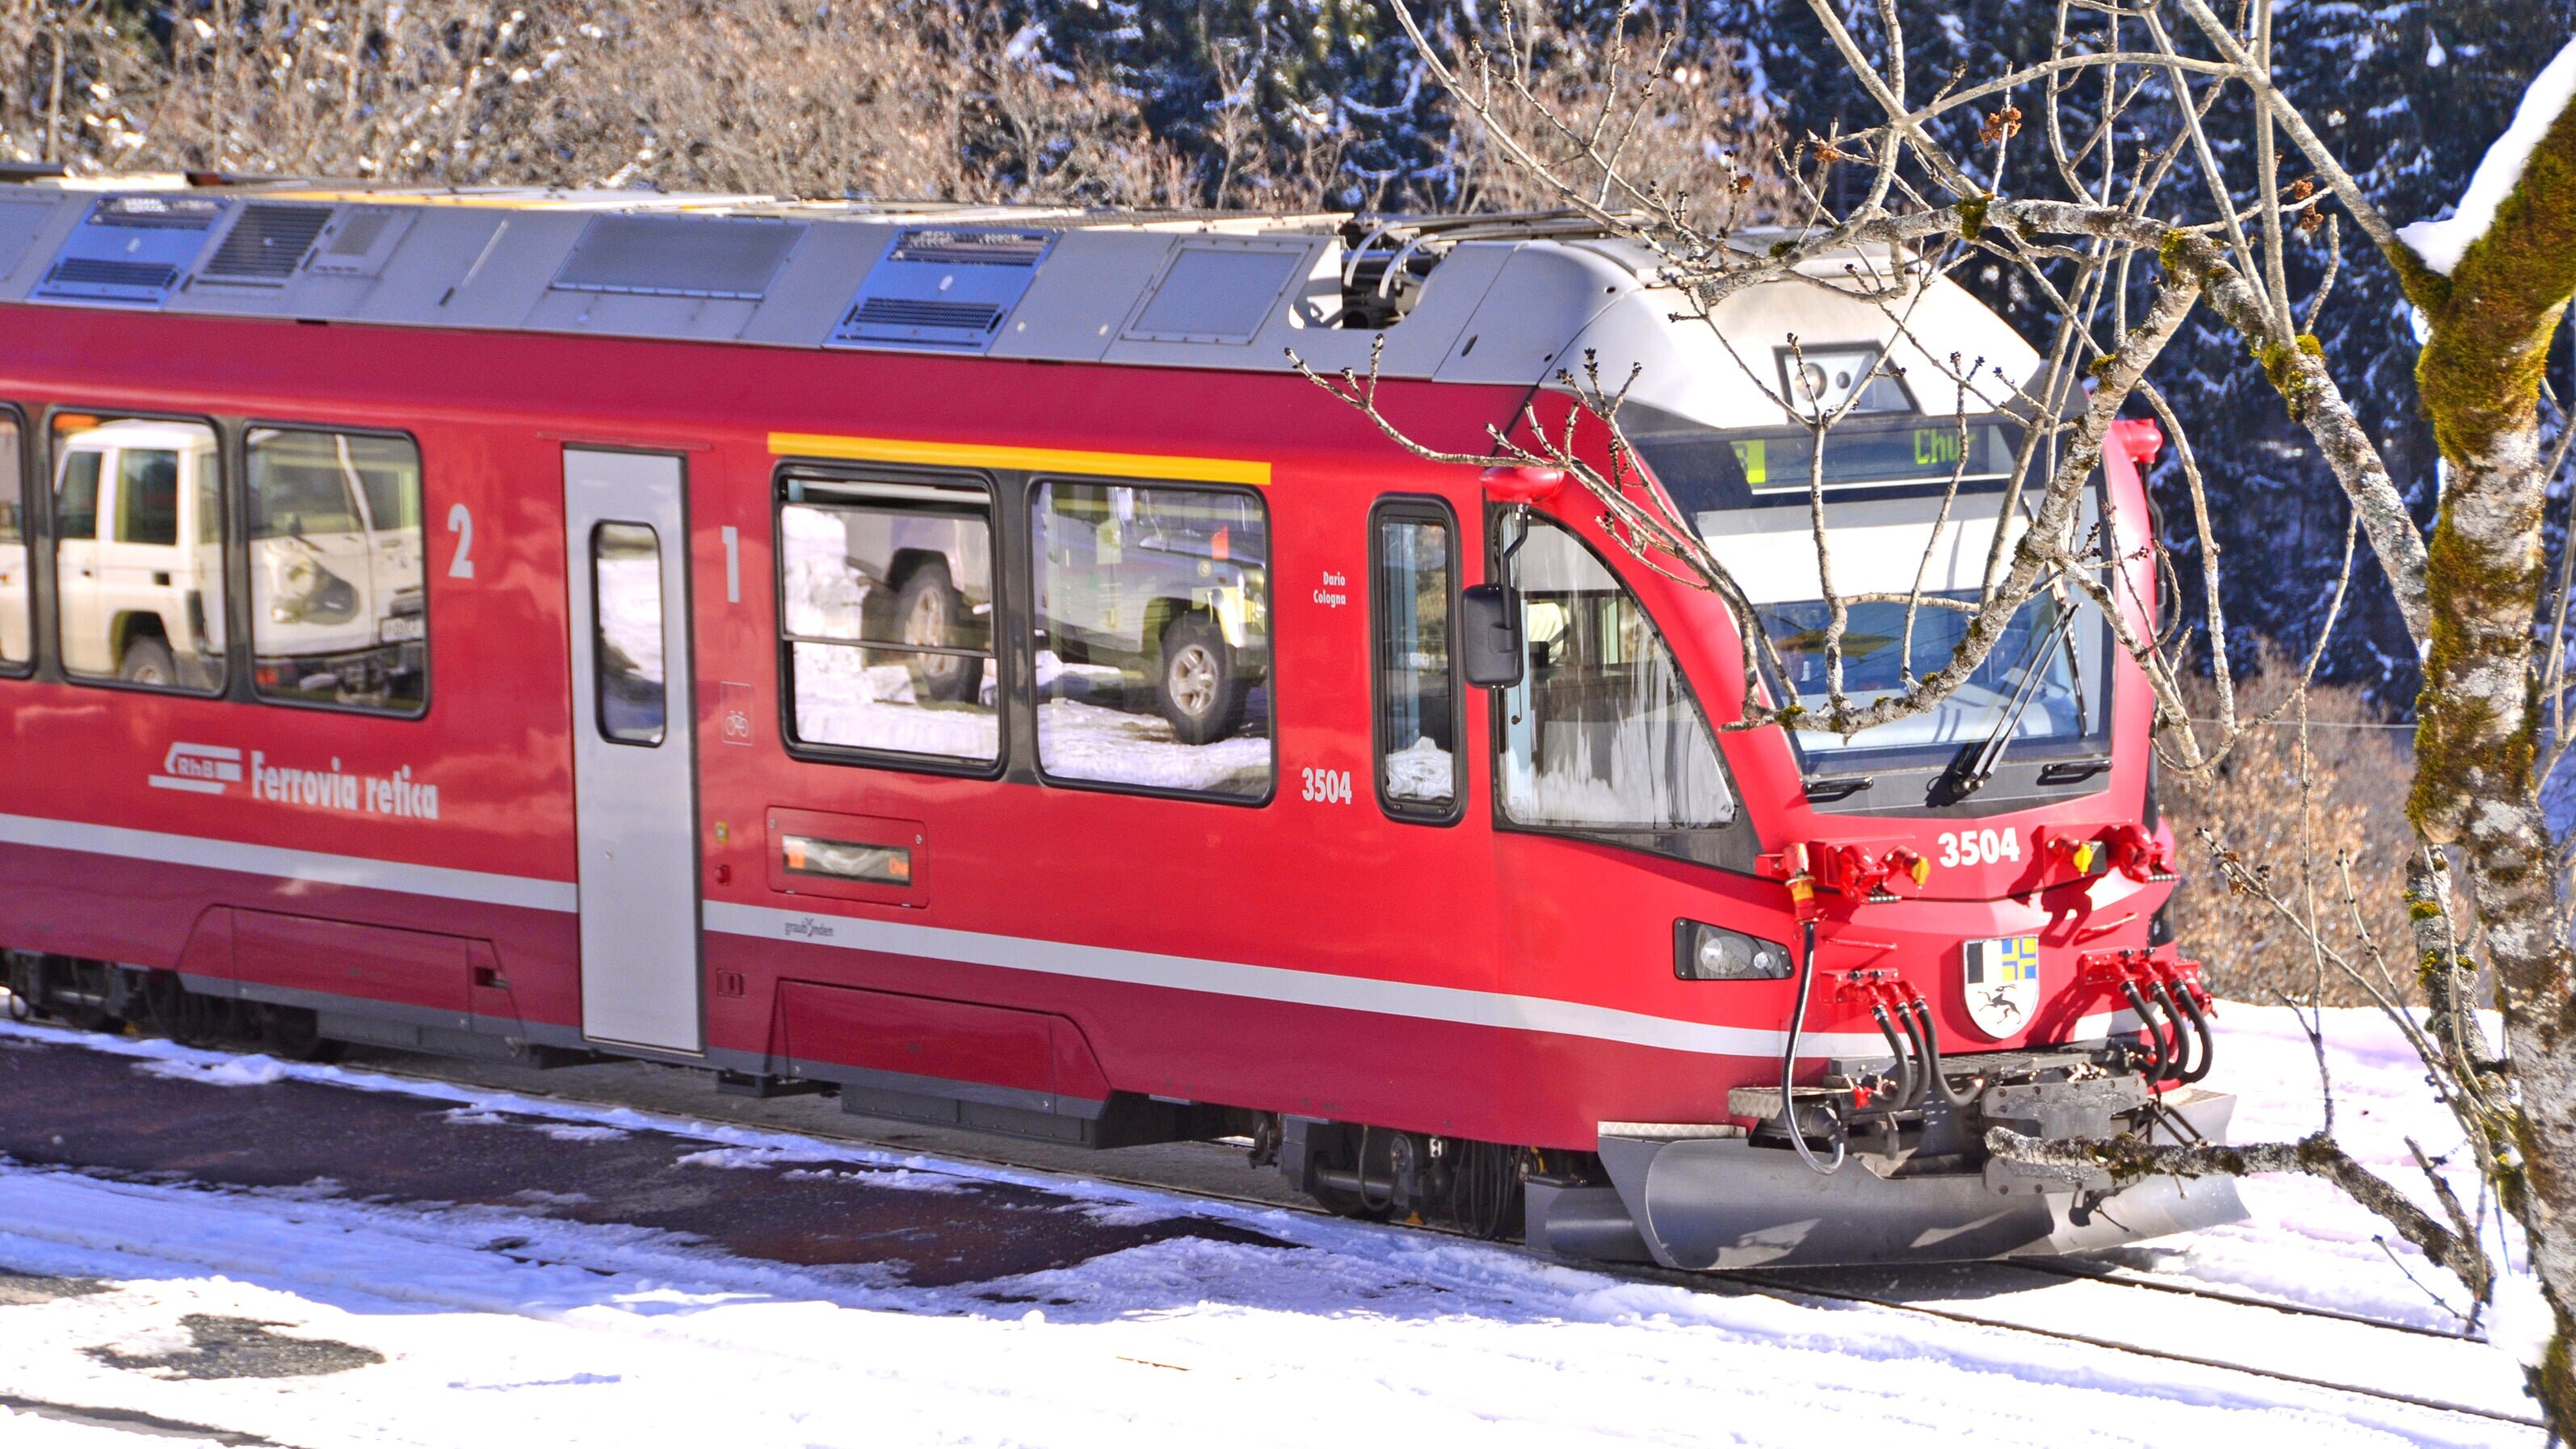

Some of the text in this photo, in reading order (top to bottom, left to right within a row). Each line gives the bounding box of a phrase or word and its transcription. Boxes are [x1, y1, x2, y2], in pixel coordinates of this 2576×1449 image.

[448, 502, 474, 578] 2
[721, 526, 741, 603] 1
[1323, 571, 1346, 586] Dario
[1313, 590, 1347, 608] Cologna
[178, 756, 214, 778] RhB
[251, 750, 439, 819] Ferrovia retica
[1302, 766, 1352, 805] 3504
[1938, 827, 2020, 867] 3504
